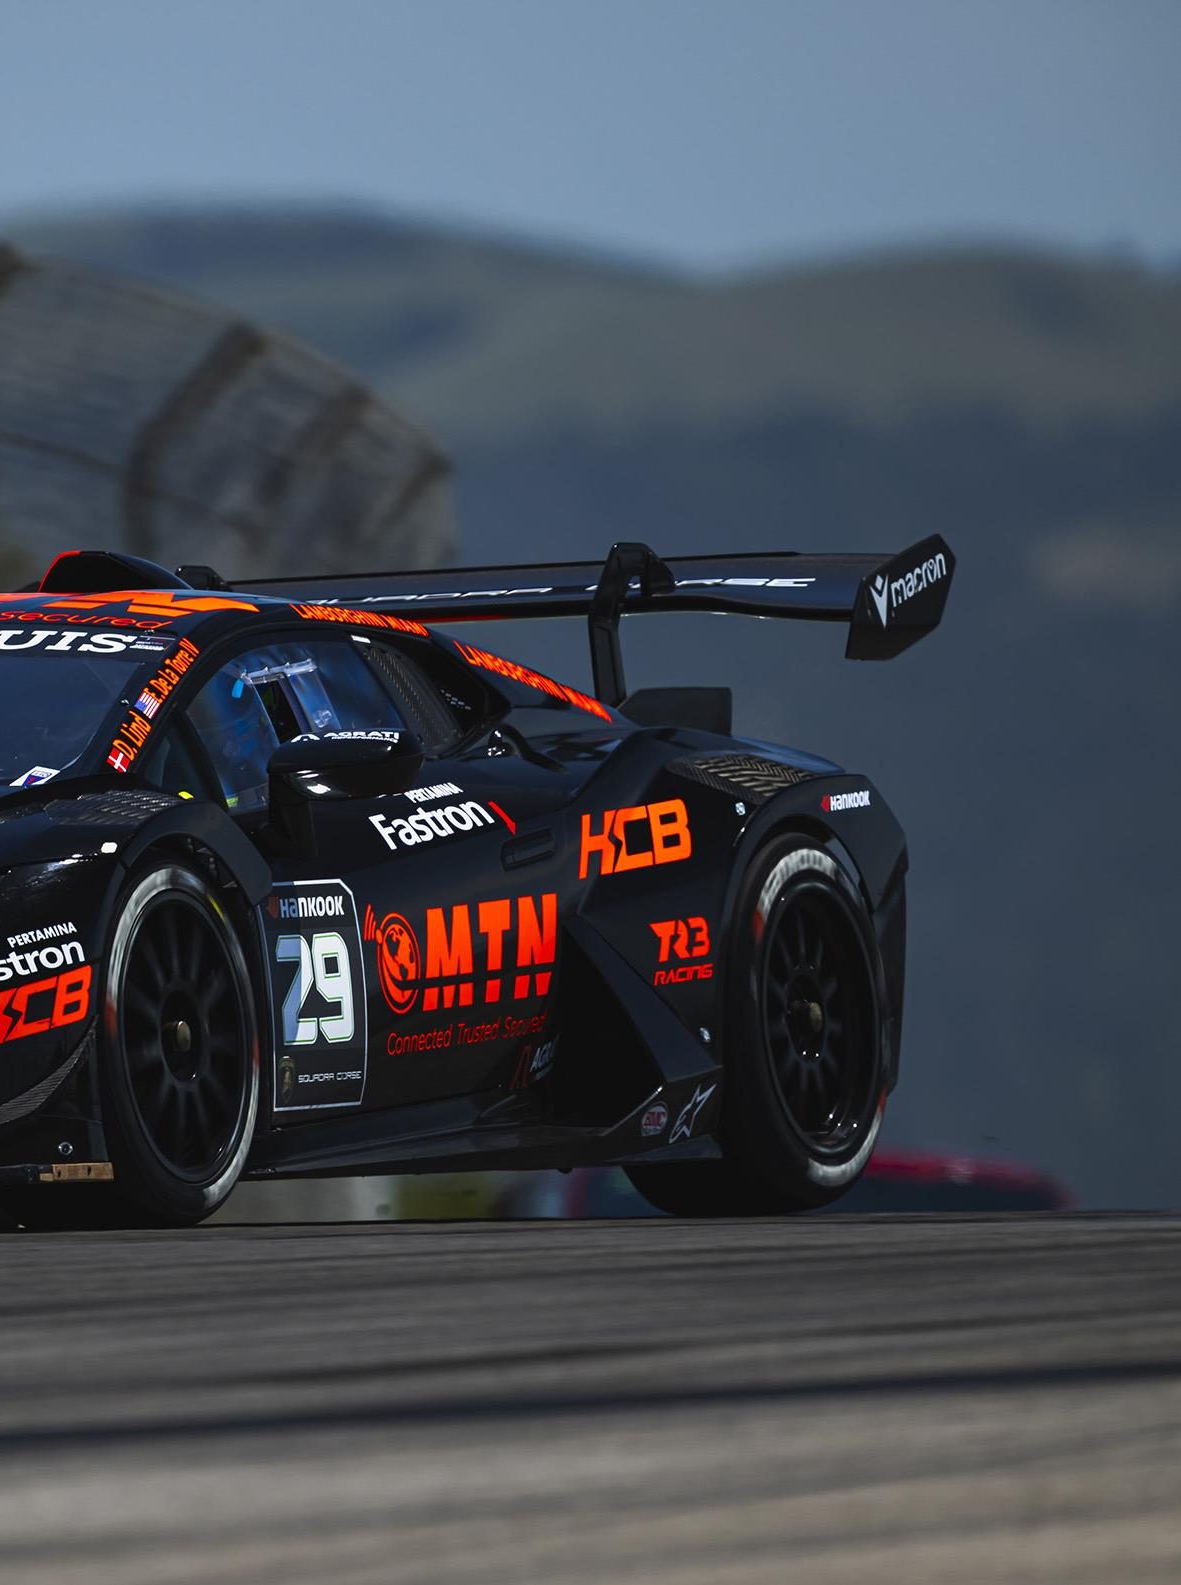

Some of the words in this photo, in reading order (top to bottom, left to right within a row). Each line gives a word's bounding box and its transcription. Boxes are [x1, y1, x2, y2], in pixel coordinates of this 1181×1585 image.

[890, 552, 947, 608] macron
[289, 603, 389, 628] LAMBORGHINI
[164, 649, 195, 675] Torre
[149, 677, 173, 699] De
[158, 669, 180, 685] La
[120, 710, 152, 748] Lind
[323, 731, 399, 740] AGRATI
[112, 739, 138, 761] D.
[404, 782, 464, 803] PERTAMINA
[368, 801, 495, 850] Fastron
[579, 798, 692, 880] HCB
[7, 922, 78, 948] PERTAMINA
[423, 893, 557, 1012] MTN
[654, 963, 713, 986] RACING
[275, 932, 355, 1046] 29
[387, 1024, 454, 1056] Connected
[457, 1017, 502, 1045] Trusted
[298, 1072, 335, 1084] SQUADRA
